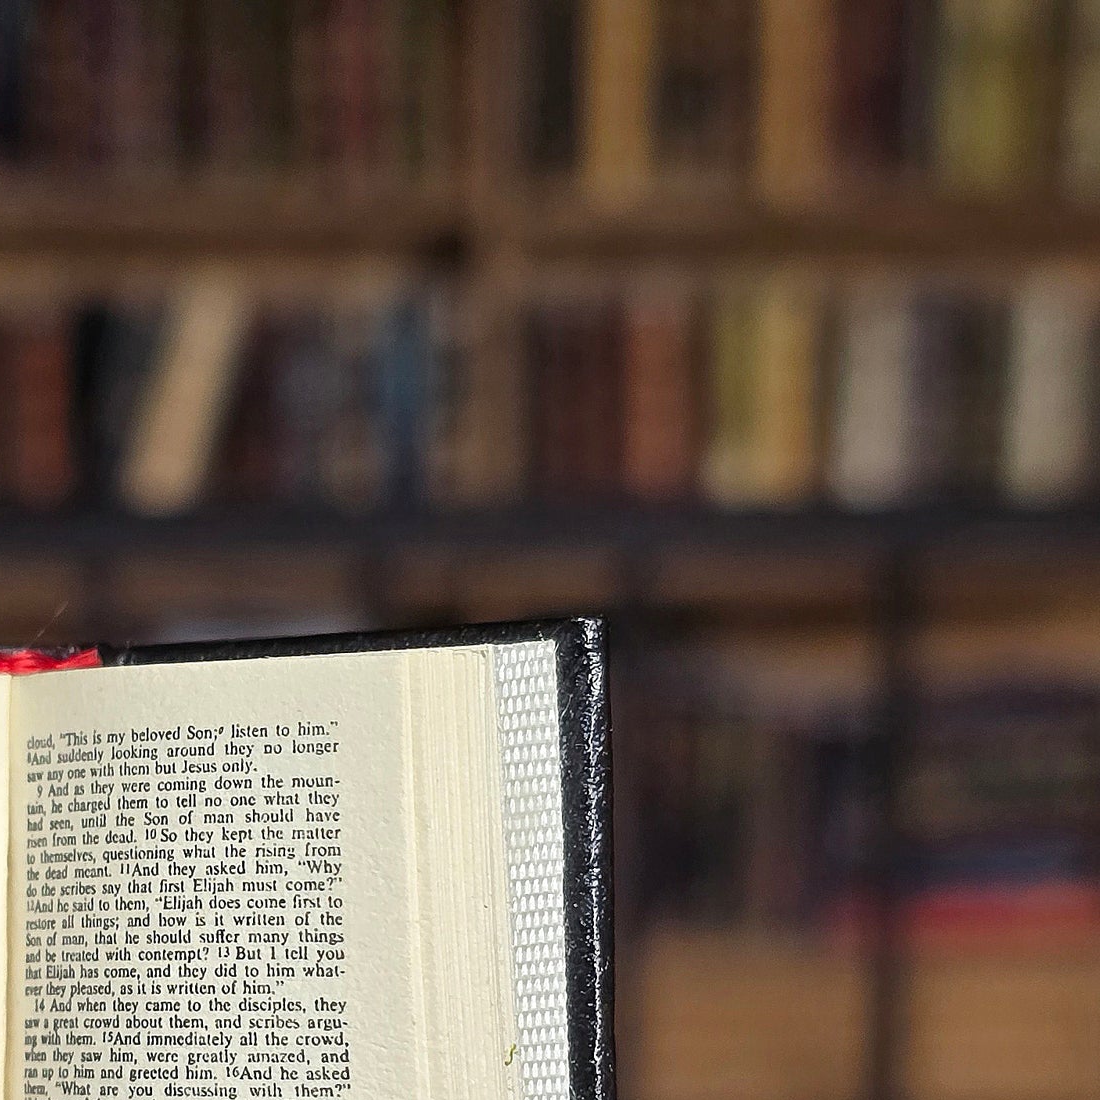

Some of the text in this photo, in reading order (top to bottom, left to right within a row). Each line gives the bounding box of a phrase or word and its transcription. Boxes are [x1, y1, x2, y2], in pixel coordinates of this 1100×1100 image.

[47, 781, 69, 797] And
[73, 784, 85, 795] as
[90, 779, 115, 798] they
[121, 781, 151, 793] were
[156, 776, 207, 795] coming
[213, 775, 253, 790] down
[260, 774, 284, 788] the
[291, 777, 340, 788] moun-
[26, 842, 342, 865] to themselves, questioning what the rising from
[25, 883, 38, 897] do
[41, 882, 56, 897] the
[59, 881, 97, 896] scribes
[127, 879, 152, 894] that
[159, 878, 185, 893] first
[192, 878, 234, 896] Elijah
[242, 879, 277, 892] must
[25, 928, 345, 948] Son of man, that he should suffer many things
[49, 998, 72, 1012] And
[76, 998, 107, 1012] when
[112, 998, 139, 1015] they
[145, 1001, 181, 1012] came
[187, 999, 202, 1012] to
[208, 997, 231, 1011] the
[238, 997, 306, 1015] disciples,
[314, 997, 347, 1015] they
[24, 1048, 47, 1062] when
[52, 1048, 75, 1065] they
[80, 1051, 103, 1062] saw
[109, 1048, 138, 1064] him,
[146, 1052, 179, 1062] were
[187, 1048, 238, 1066] greatly
[320, 1049, 350, 1063] and
